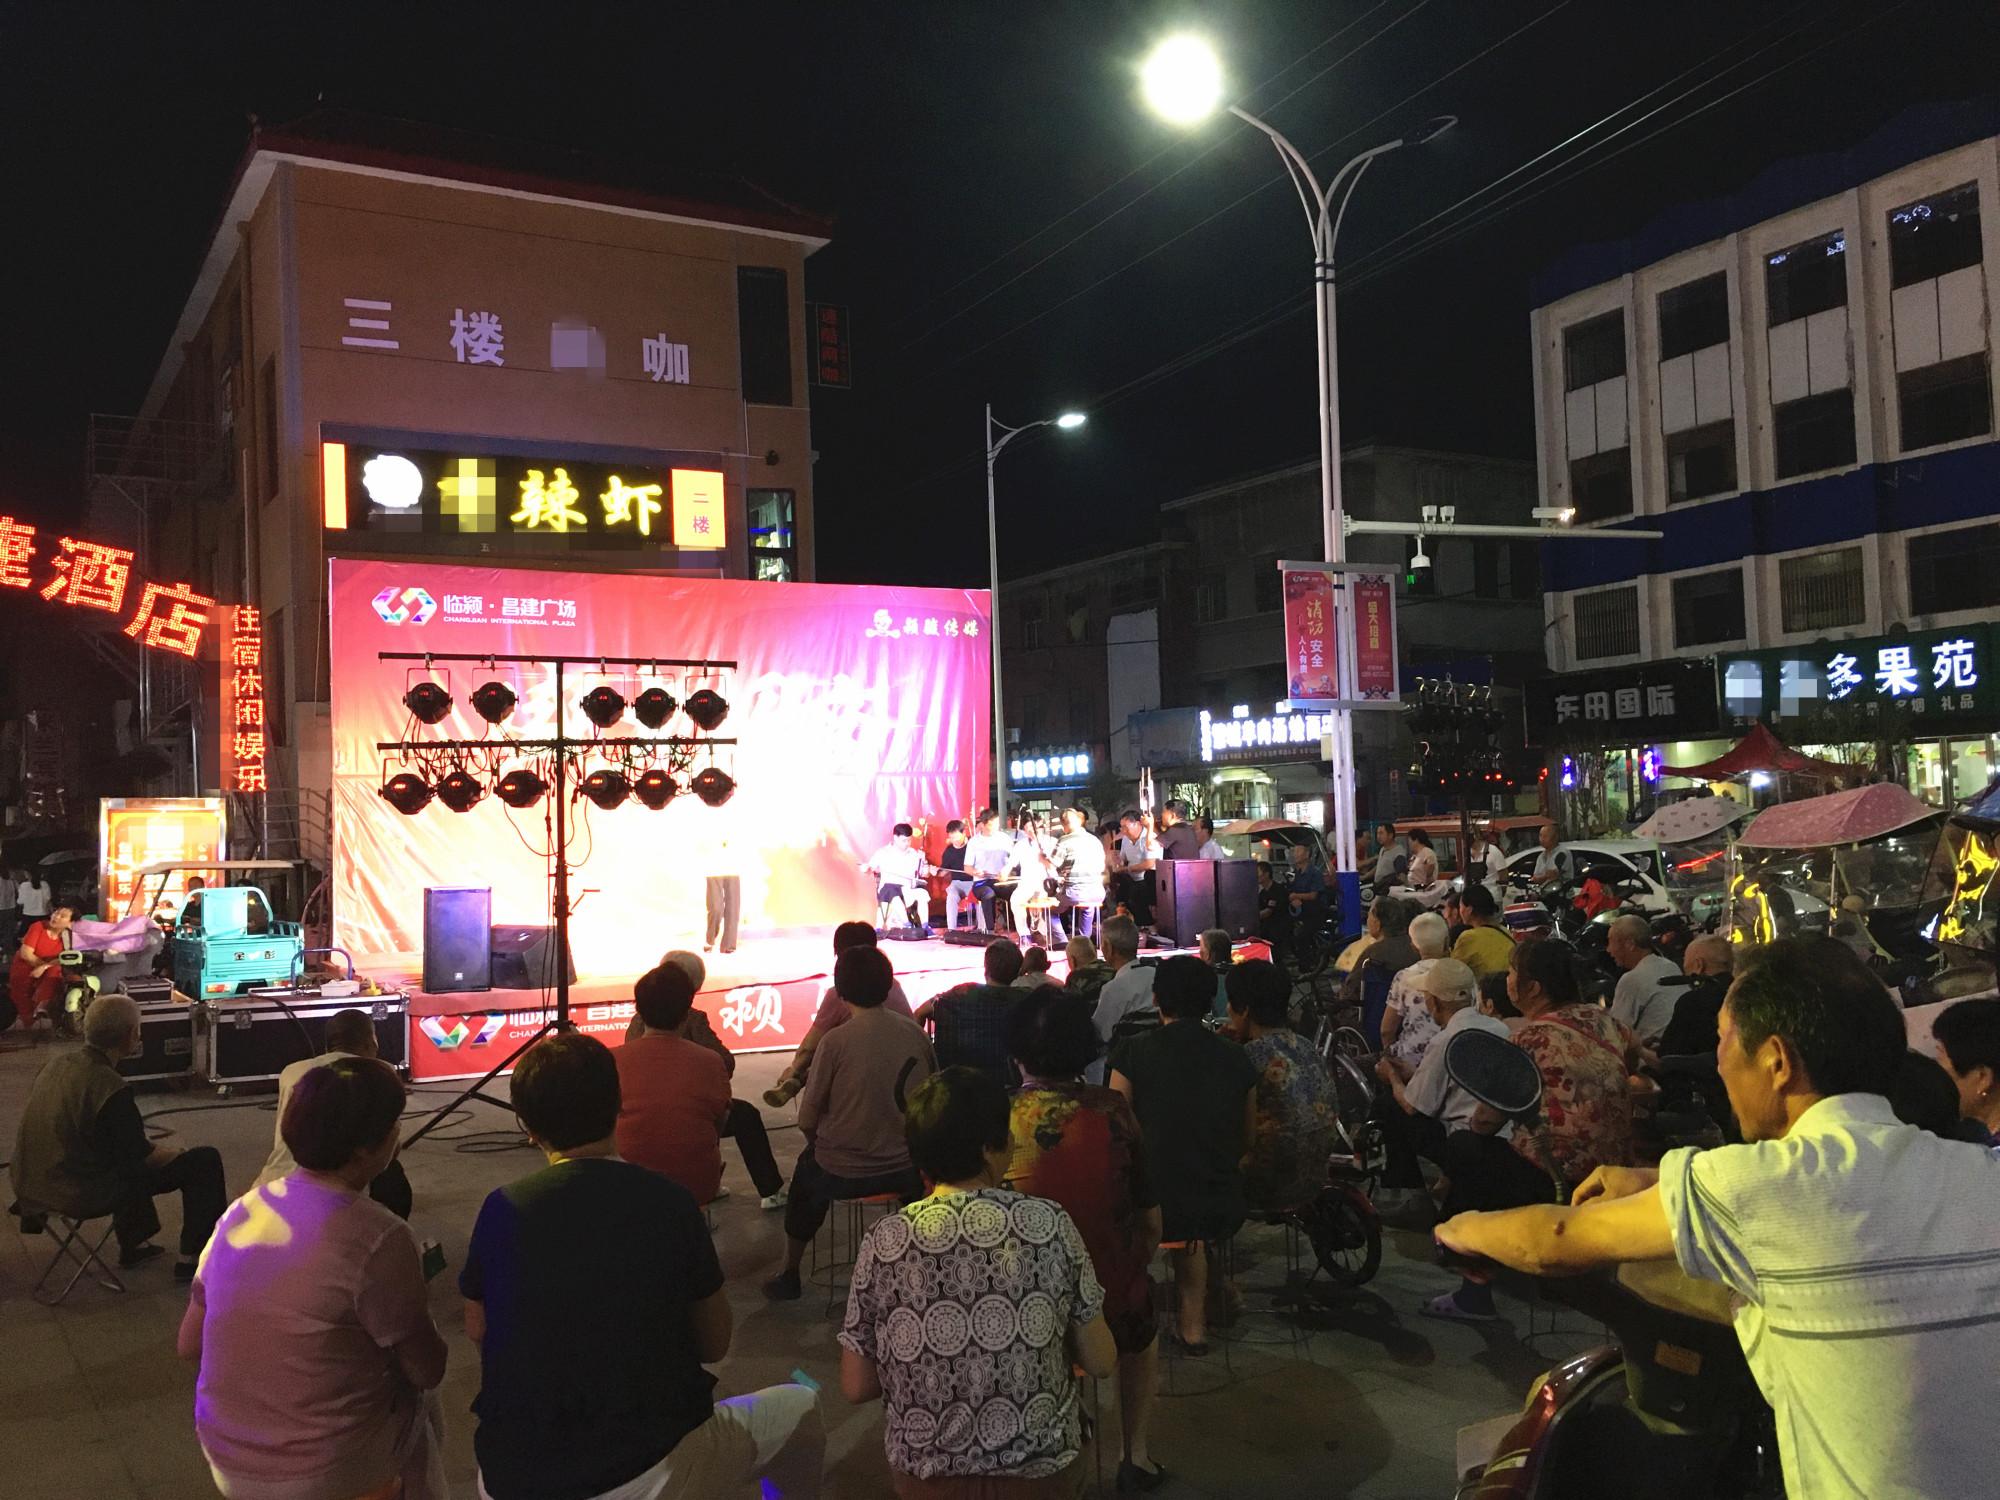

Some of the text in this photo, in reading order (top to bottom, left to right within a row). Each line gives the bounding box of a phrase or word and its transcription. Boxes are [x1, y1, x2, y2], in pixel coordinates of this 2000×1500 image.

[342, 298, 690, 384] 三楼咖
[443, 616, 576, 627] CHANGJIAN INTERNATIONAL PLAZA
[231, 605, 267, 791] 住宿休闲娱乐
[1941, 693, 1974, 711] 礼品
